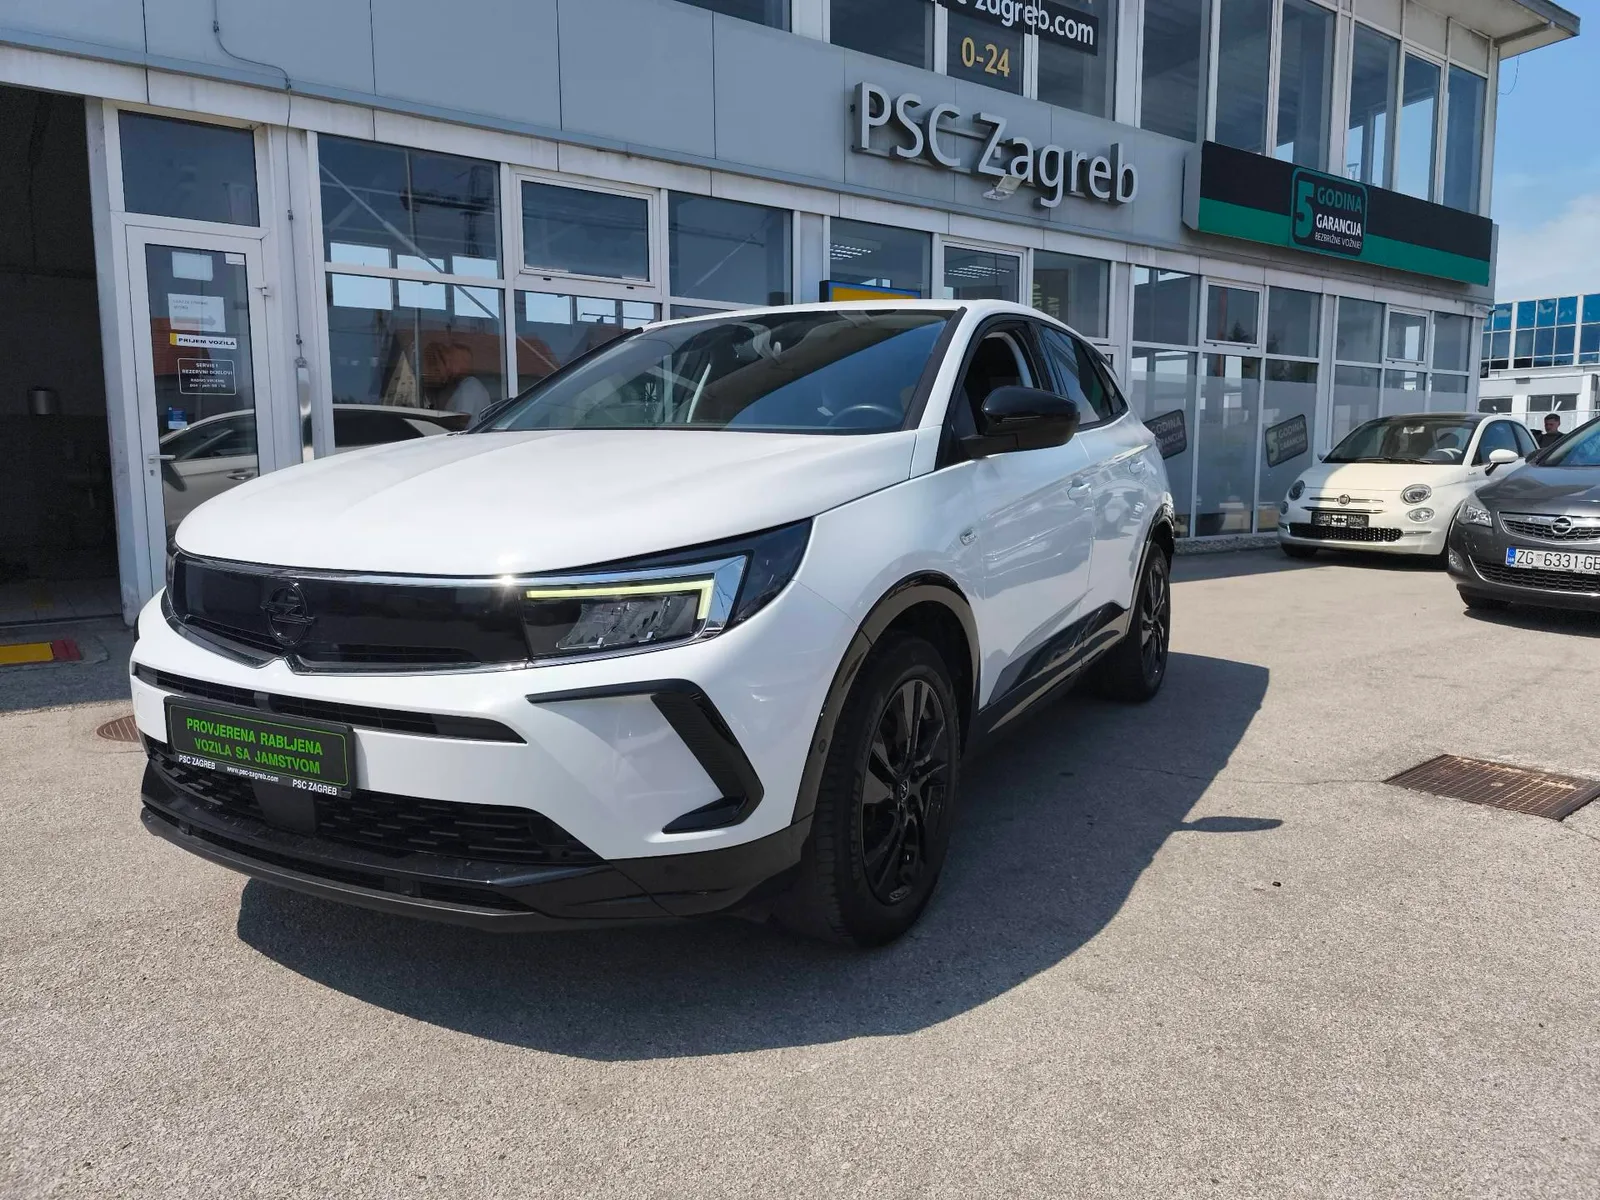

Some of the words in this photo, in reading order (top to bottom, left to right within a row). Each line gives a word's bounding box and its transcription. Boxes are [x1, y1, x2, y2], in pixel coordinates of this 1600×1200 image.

[957, 0, 1093, 45] zagreb.com
[961, 37, 1010, 77] 0-24
[854, 81, 961, 168] PSC
[972, 111, 1139, 208] Zagreb
[1295, 180, 1315, 238] 5
[1317, 186, 1362, 214] GODINA
[1316, 213, 1362, 237] GARANCIJA
[1314, 231, 1341, 245] BEZBRIŽNE
[1278, 420, 1304, 439] GODINA
[1517, 550, 1534, 565] ZG
[186, 717, 256, 744] PROVJERENA
[260, 732, 323, 756] RABLJENA
[178, 754, 191, 765] PSC
[191, 756, 216, 770] ZAGREB
[194, 737, 232, 757] VOZILA
[235, 746, 250, 761] SA
[254, 750, 321, 775] JAMSTVOM
[226, 765, 279, 783] www.psc-zagreb.com
[292, 778, 308, 790] PSC
[308, 782, 338, 796] ZAGREB
